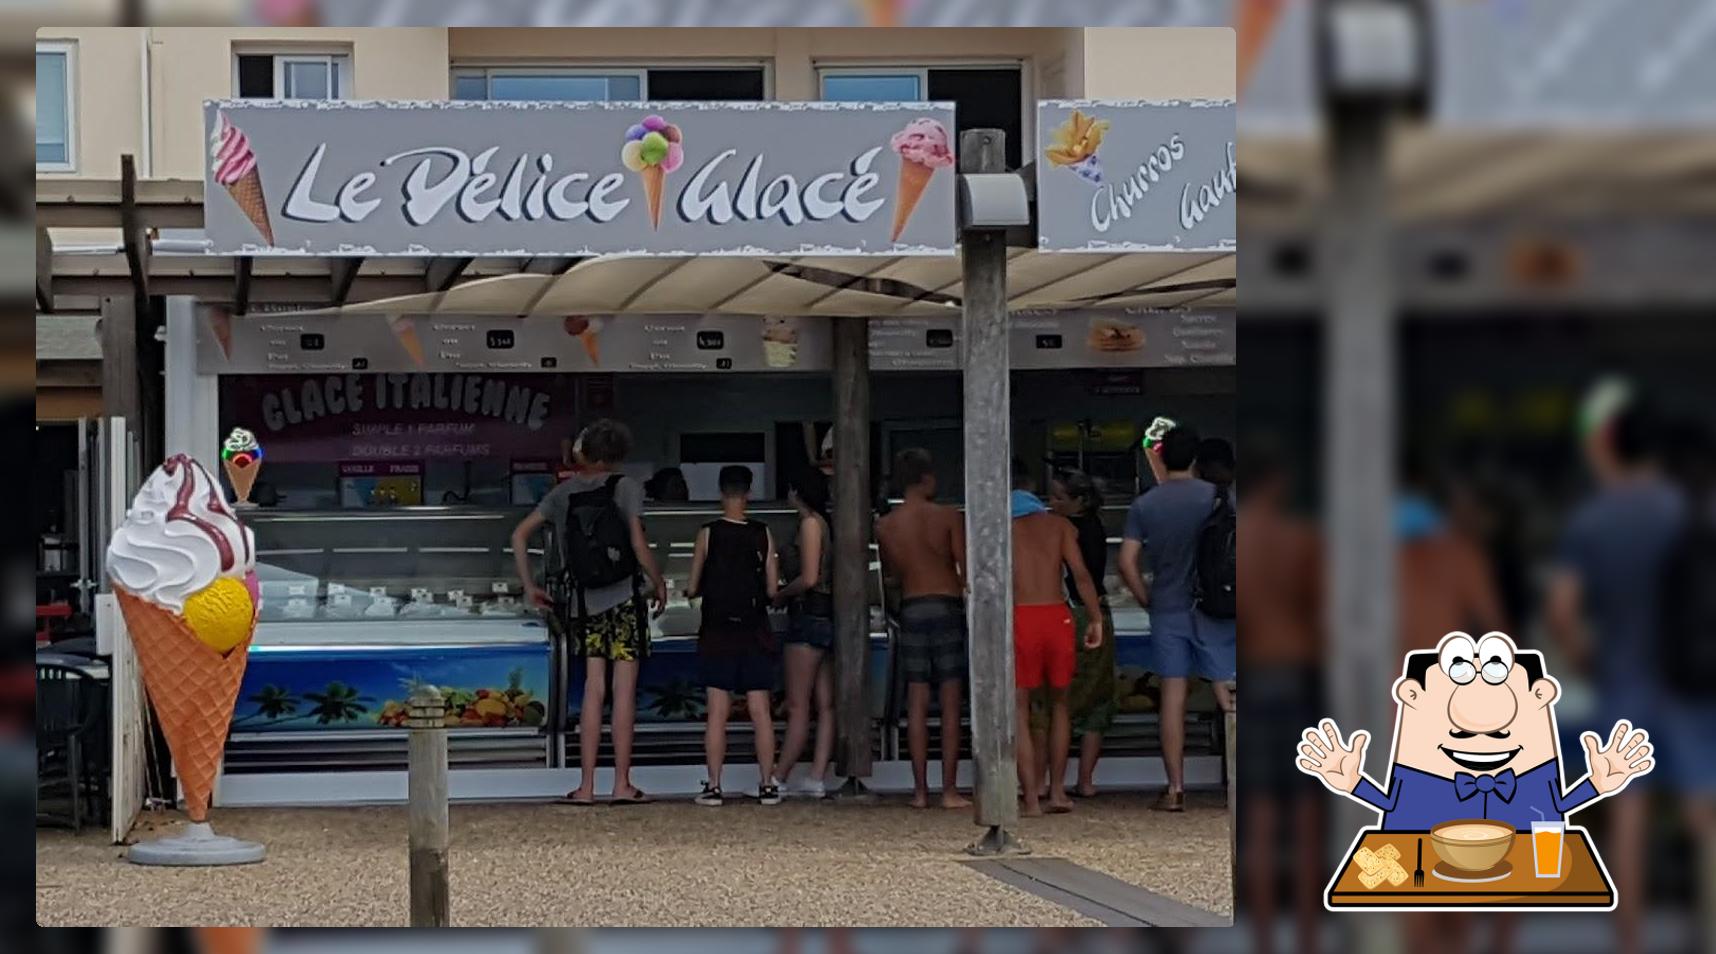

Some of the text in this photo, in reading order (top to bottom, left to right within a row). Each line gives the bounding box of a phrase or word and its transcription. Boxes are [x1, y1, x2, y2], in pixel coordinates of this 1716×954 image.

[282, 142, 885, 227] Le Délice Glacé
[1091, 132, 1185, 232] Churros
[261, 373, 551, 431] GLACE ITALIENNE
[352, 423, 402, 436] SIMPLE
[352, 444, 409, 457] DOUBLE
